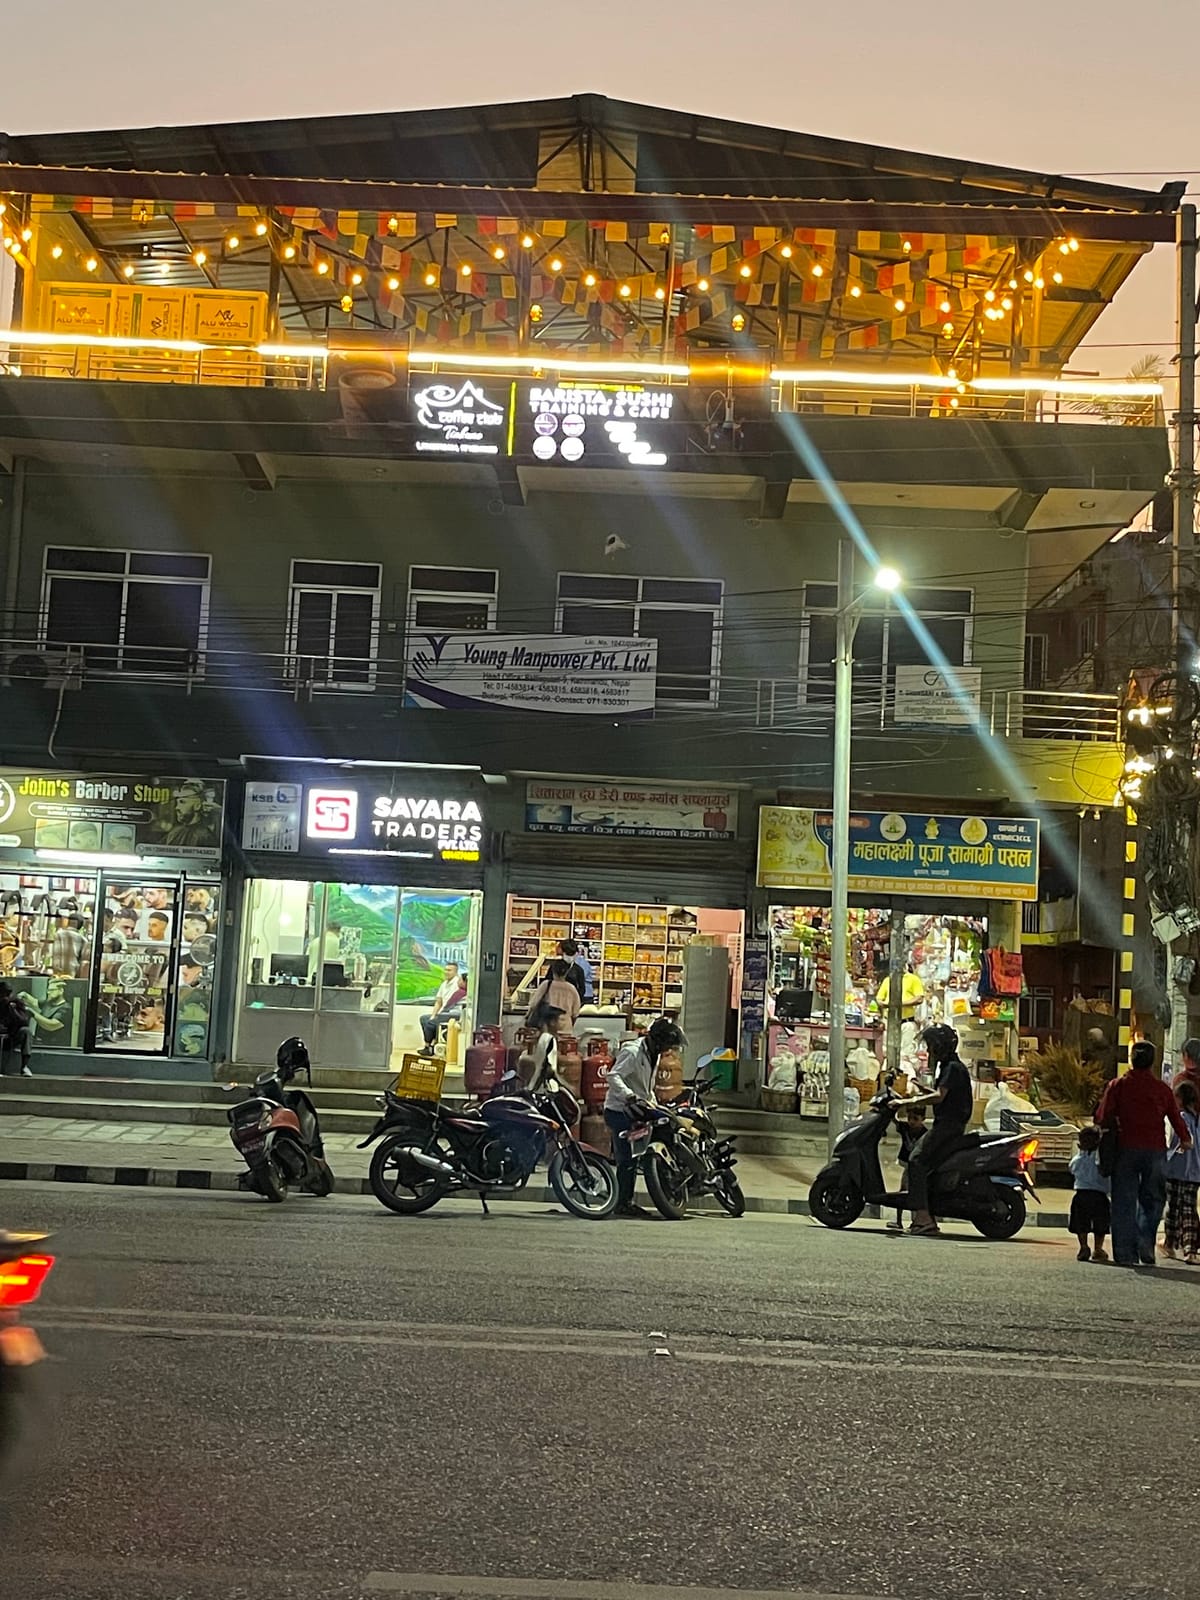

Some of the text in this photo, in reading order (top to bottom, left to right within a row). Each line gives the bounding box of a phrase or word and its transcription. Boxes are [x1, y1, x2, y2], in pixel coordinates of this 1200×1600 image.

[200, 320, 249, 329] ALU WORLD
[529, 387, 613, 406] BARISTA,
[615, 391, 673, 408] SUSHI
[529, 401, 670, 419] TRAINING & CAFE
[464, 643, 652, 673] Young Manpower Pvt. Ltd.
[19, 776, 171, 805] John's Barber Shop
[373, 796, 482, 822] SAYARA
[372, 820, 482, 842] TRADERS
[853, 839, 1032, 869] महालक्ष्मी पूजा सामाग्री पसल
[106, 953, 165, 964] WELCOME TO
